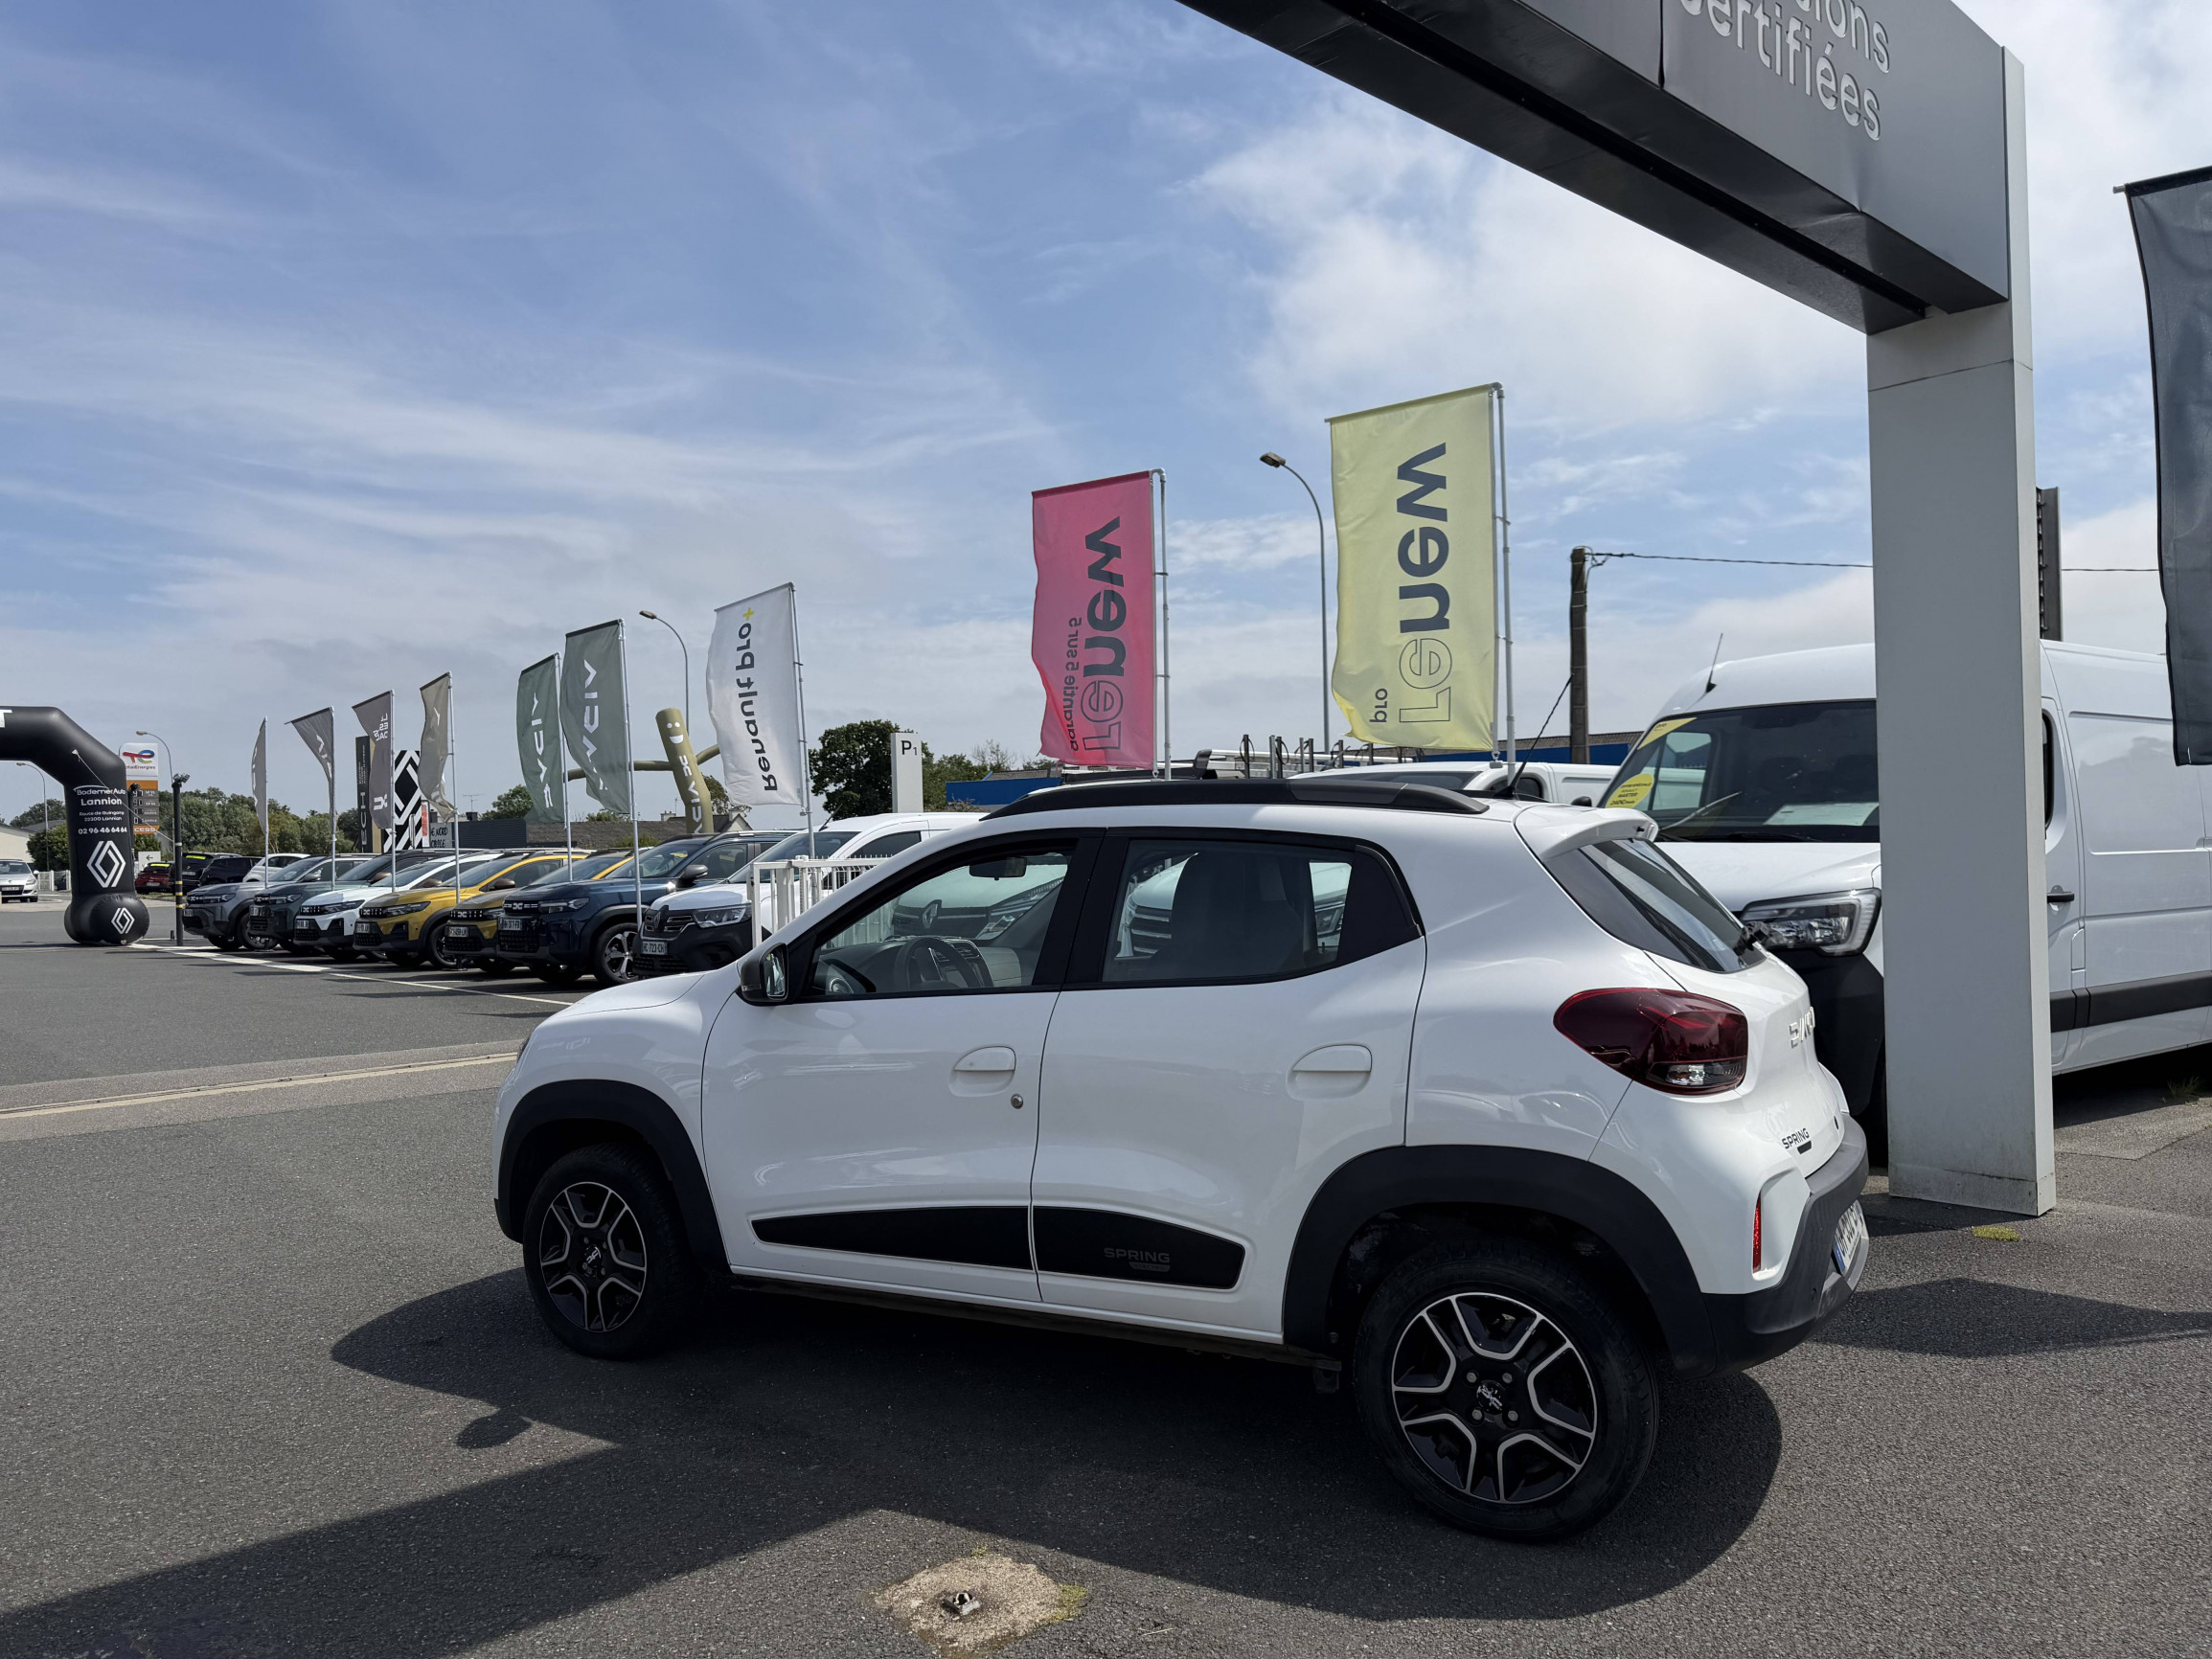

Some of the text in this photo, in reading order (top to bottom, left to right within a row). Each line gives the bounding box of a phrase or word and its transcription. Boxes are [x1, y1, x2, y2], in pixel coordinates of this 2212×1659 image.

[1681, 0, 1881, 141] ertifiées
[80, 797, 122, 806] Lannion
[1781, 1127, 1810, 1149] SPRING
[1104, 1247, 1171, 1263] SPRING
